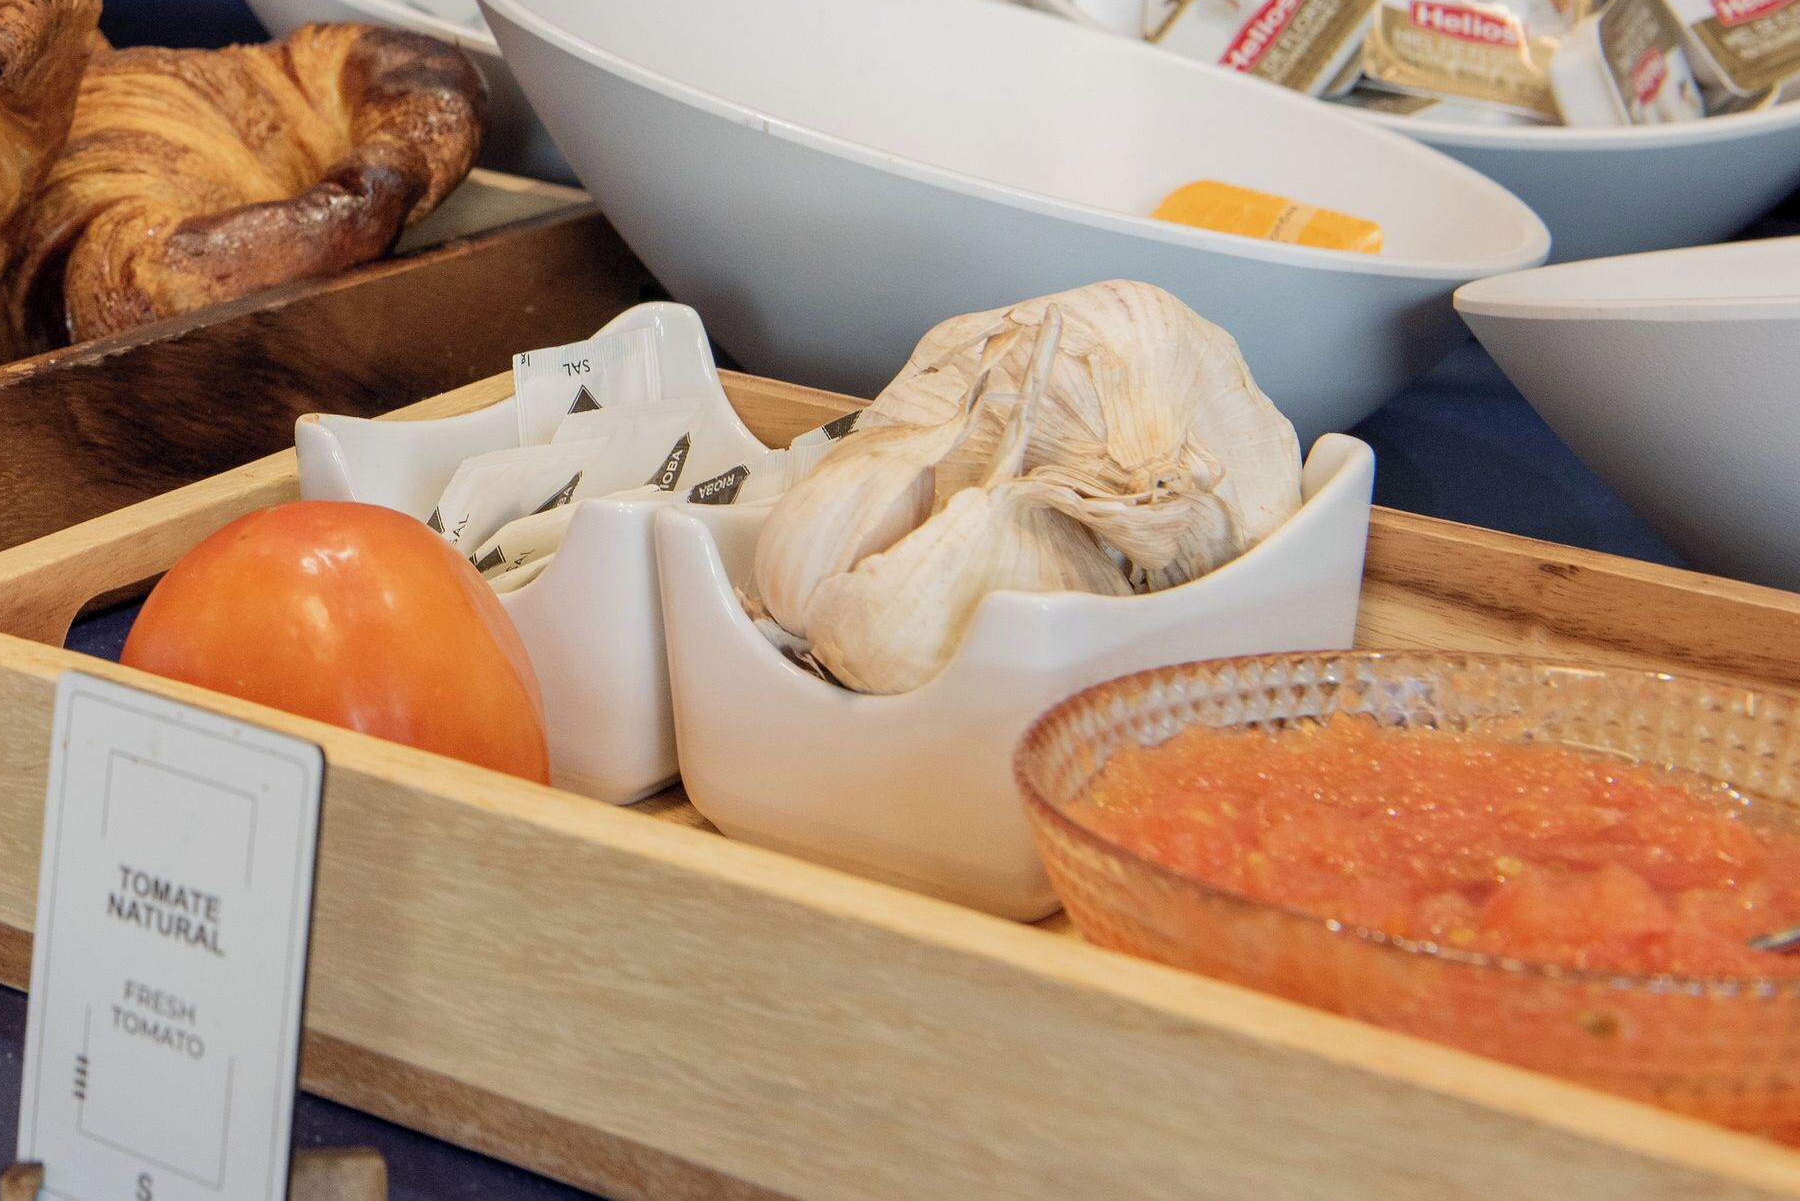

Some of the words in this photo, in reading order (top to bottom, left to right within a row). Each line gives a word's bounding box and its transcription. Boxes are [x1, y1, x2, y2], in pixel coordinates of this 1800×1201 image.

[1415, 3, 1520, 47] Helios
[562, 359, 592, 377] SAL
[659, 449, 683, 490] IOBA
[699, 473, 735, 499] RIOBA
[118, 864, 221, 923] TOMATE
[106, 892, 226, 957] NATURAL
[123, 979, 198, 1025] FRESH
[111, 1004, 206, 1060] TOMATO
